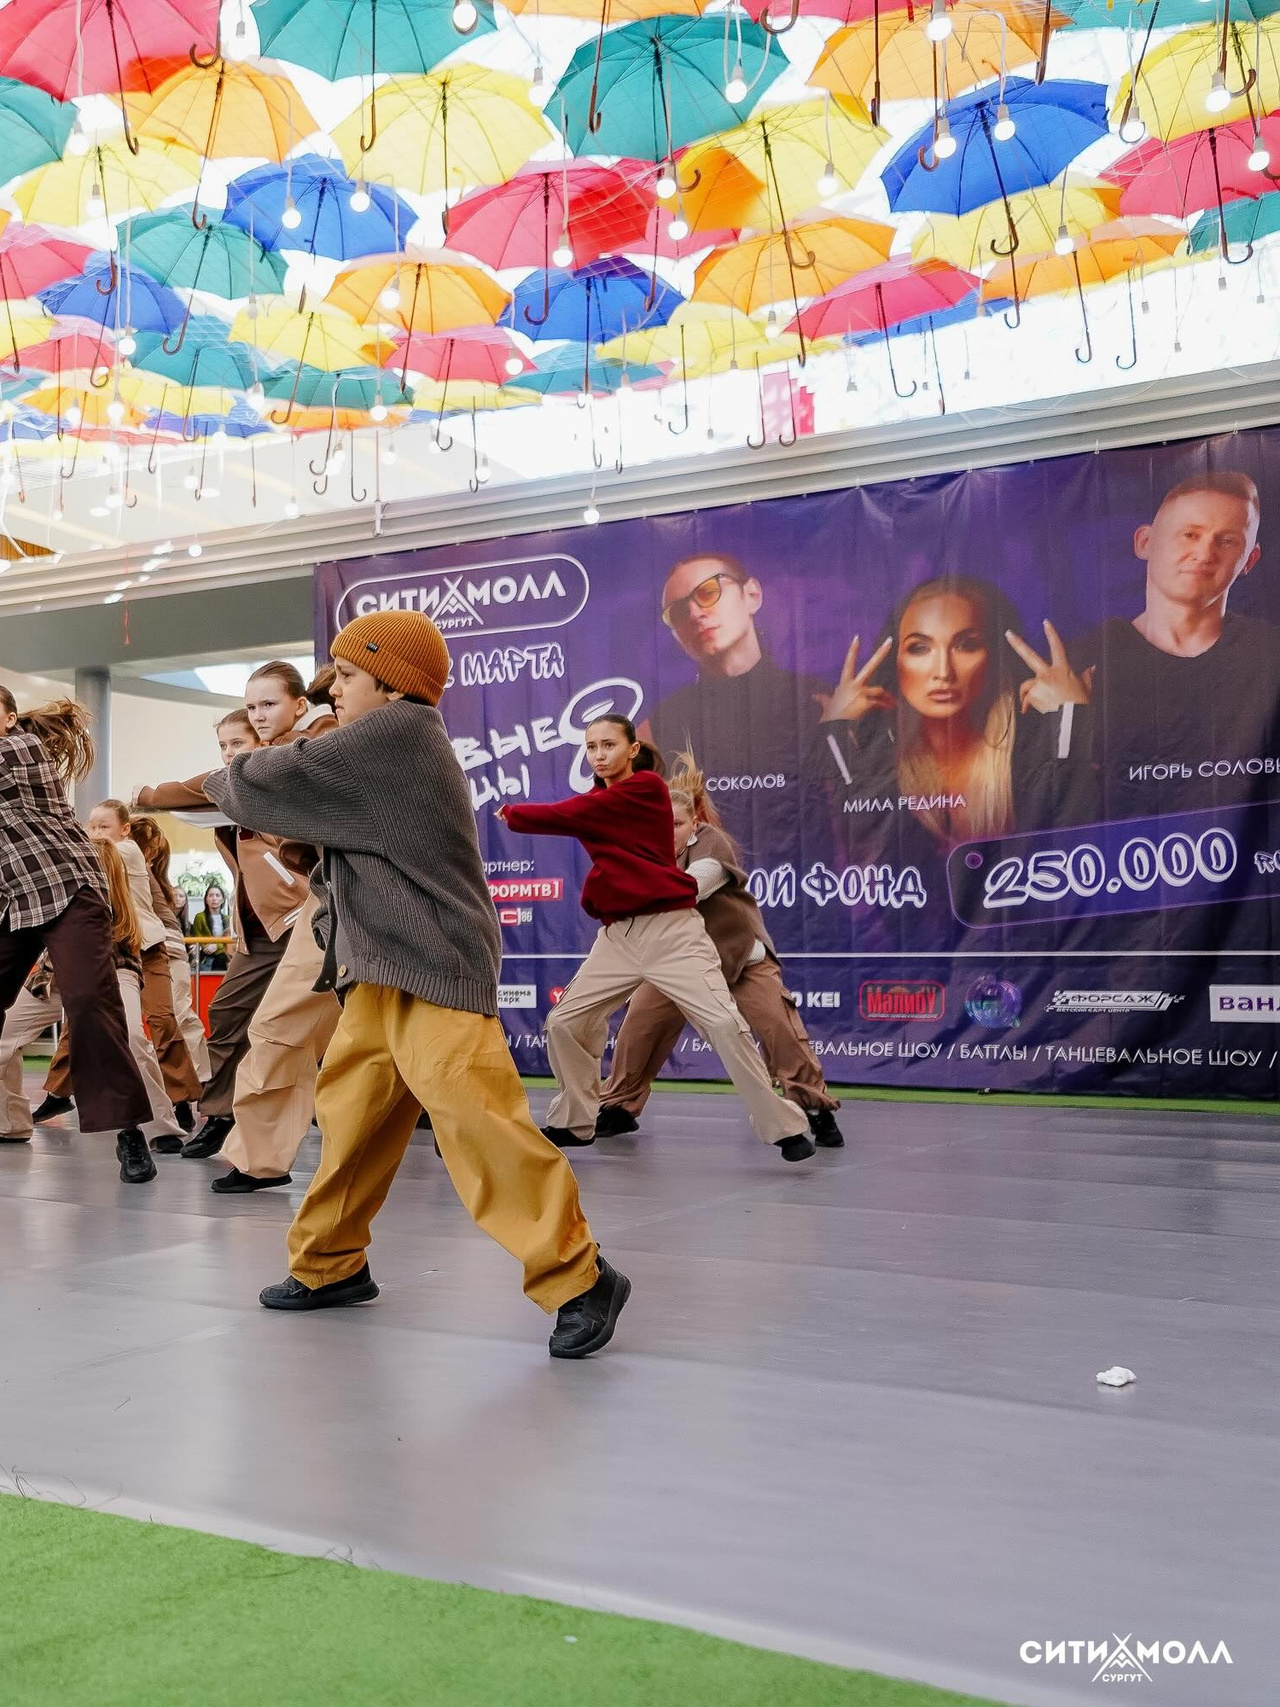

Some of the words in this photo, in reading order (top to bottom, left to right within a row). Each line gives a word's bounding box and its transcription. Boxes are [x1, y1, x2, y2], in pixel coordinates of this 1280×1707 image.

[356, 586, 440, 617] СИТИ
[467, 570, 566, 606] МОЛЛ
[460, 642, 564, 687] МАРТА
[1128, 762, 1193, 781] ИГОРЬ
[1198, 757, 1280, 778] СОЛОВ
[705, 773, 786, 792] СОКОЛОВ
[843, 797, 894, 814] МИЛА
[898, 794, 968, 812] РЕДИНА
[983, 826, 1237, 909] 250.000
[801, 862, 927, 909] ФОНД
[1071, 993, 1156, 1005] ФОРСАЖ
[1219, 996, 1280, 1012] ван
[898, 1042, 943, 1059] ШОУ
[960, 1043, 1028, 1062] БАТТЛЫ
[1045, 1045, 1203, 1066] ТАНЦЕВАЛЬНОЕ
[1208, 1048, 1263, 1067] ШОУ
